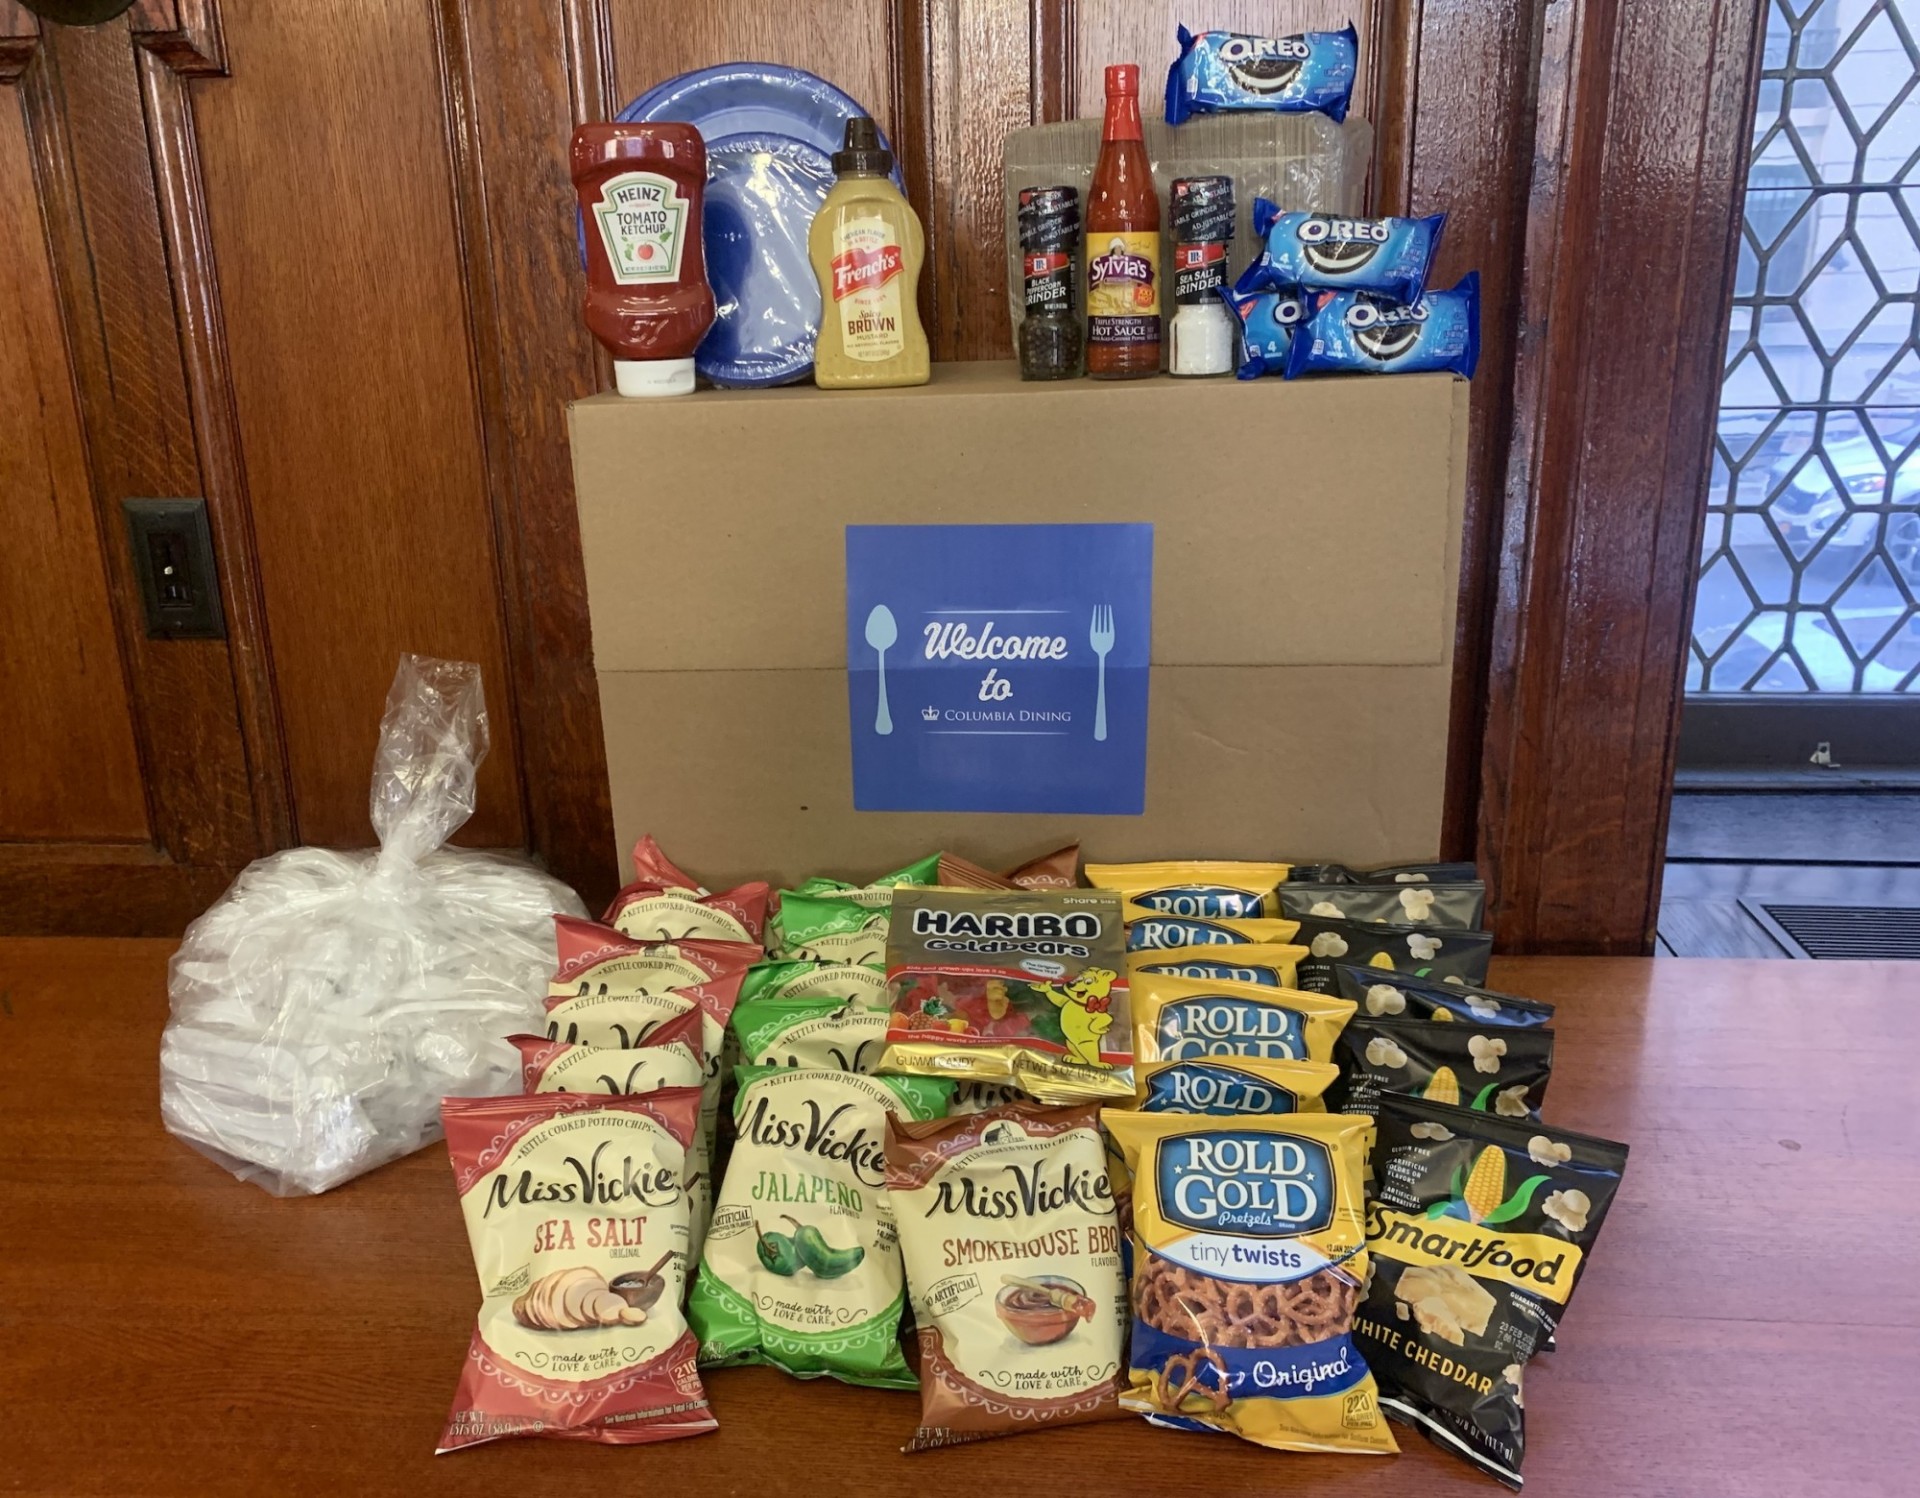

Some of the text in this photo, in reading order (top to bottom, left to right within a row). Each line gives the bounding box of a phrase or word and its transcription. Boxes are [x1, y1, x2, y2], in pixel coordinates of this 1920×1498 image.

[1219, 38, 1310, 61] OREO
[616, 187, 661, 203] HEINZ
[616, 210, 667, 225] TOMATO
[620, 223, 666, 235] KETCHUP
[1298, 219, 1390, 242] OREO
[834, 252, 896, 290] French's
[1092, 256, 1147, 281] Sylvia's
[1180, 268, 1215, 285] SEA SALT
[1031, 276, 1050, 287] BLACK
[1175, 275, 1222, 297] GRINDER
[848, 317, 895, 335] BROWN
[1111, 317, 1142, 326] STRENGTH
[856, 333, 888, 341] MUSTARD
[1092, 326, 1113, 336] HOT
[1114, 326, 1146, 336] SAUCE
[1267, 341, 1277, 352] 4
[924, 621, 1068, 660] Welcome
[978, 668, 1013, 701] to
[863, 893, 892, 902] POTATO
[1063, 897, 1098, 905] Share
[1151, 894, 1244, 918] ROLD
[627, 902, 735, 932] KETTLE COOKED POTATO CHIPS
[912, 908, 1102, 940] HARIBO
[820, 937, 850, 947] KETTLE
[924, 938, 1091, 958] Goldbears
[601, 961, 632, 974] KETTLE
[632, 960, 664, 970] COOKED
[783, 970, 871, 1000] KETTLE COOKED POTATO
[574, 996, 607, 1011] KETTLE
[785, 1017, 879, 1045] KETTLE COOKED POTATO
[1184, 1005, 1288, 1039] ROLD
[556, 1047, 590, 1074] KETTLE
[896, 1054, 934, 1067] GUMMI
[1012, 1060, 1031, 1070] NET
[769, 1070, 899, 1112] KETTLE COOKED POTATO CHIPS
[1170, 1071, 1273, 1113] ROLD
[520, 1117, 653, 1158] KETTLE COOKED POTATO CHIPS
[801, 1099, 886, 1188] Vickie
[1185, 1138, 1306, 1176] ROLD
[1413, 1146, 1431, 1157] FREE
[1393, 1157, 1429, 1174] ARTIFICIAL
[1387, 1170, 1416, 1185] FLAVORS
[1411, 1171, 1422, 1179] OR
[483, 1169, 578, 1219] Miss
[751, 1171, 863, 1213] JALAPEÑO
[925, 1177, 1018, 1219] Miss
[1174, 1174, 1318, 1222] GOLD
[1386, 1186, 1421, 1203] ARTIFICIAL
[829, 1205, 861, 1220] FLAVORED
[1218, 1210, 1273, 1228] Pretzels
[534, 1215, 648, 1253] SEA SALT
[609, 1247, 641, 1258] ORIGINAL
[942, 1228, 1080, 1267] SMOKEHOUSE
[1088, 1225, 1121, 1258] BBQ
[1366, 1206, 1566, 1287] Smartfood
[1190, 1242, 1229, 1267] tiny
[1230, 1243, 1302, 1269] twists
[934, 1277, 978, 1304] ARTIFICIAL
[781, 1300, 833, 1317] made with
[1510, 1291, 1546, 1317] GUARANTEED
[1512, 1301, 1527, 1313] UNTIL
[773, 1308, 795, 1321] LOVE
[806, 1313, 834, 1326] CARE
[1509, 1325, 1523, 1339] FEB
[551, 1347, 619, 1363] made with
[551, 1357, 618, 1372] LOVE & CARE
[1015, 1365, 1083, 1380] made with
[1252, 1346, 1353, 1392] Original
[1404, 1340, 1493, 1397] CHEDDAR
[1015, 1376, 1081, 1390] LOVE & CARE
[1346, 1394, 1370, 1413] 220
[471, 1423, 484, 1435] OZ
